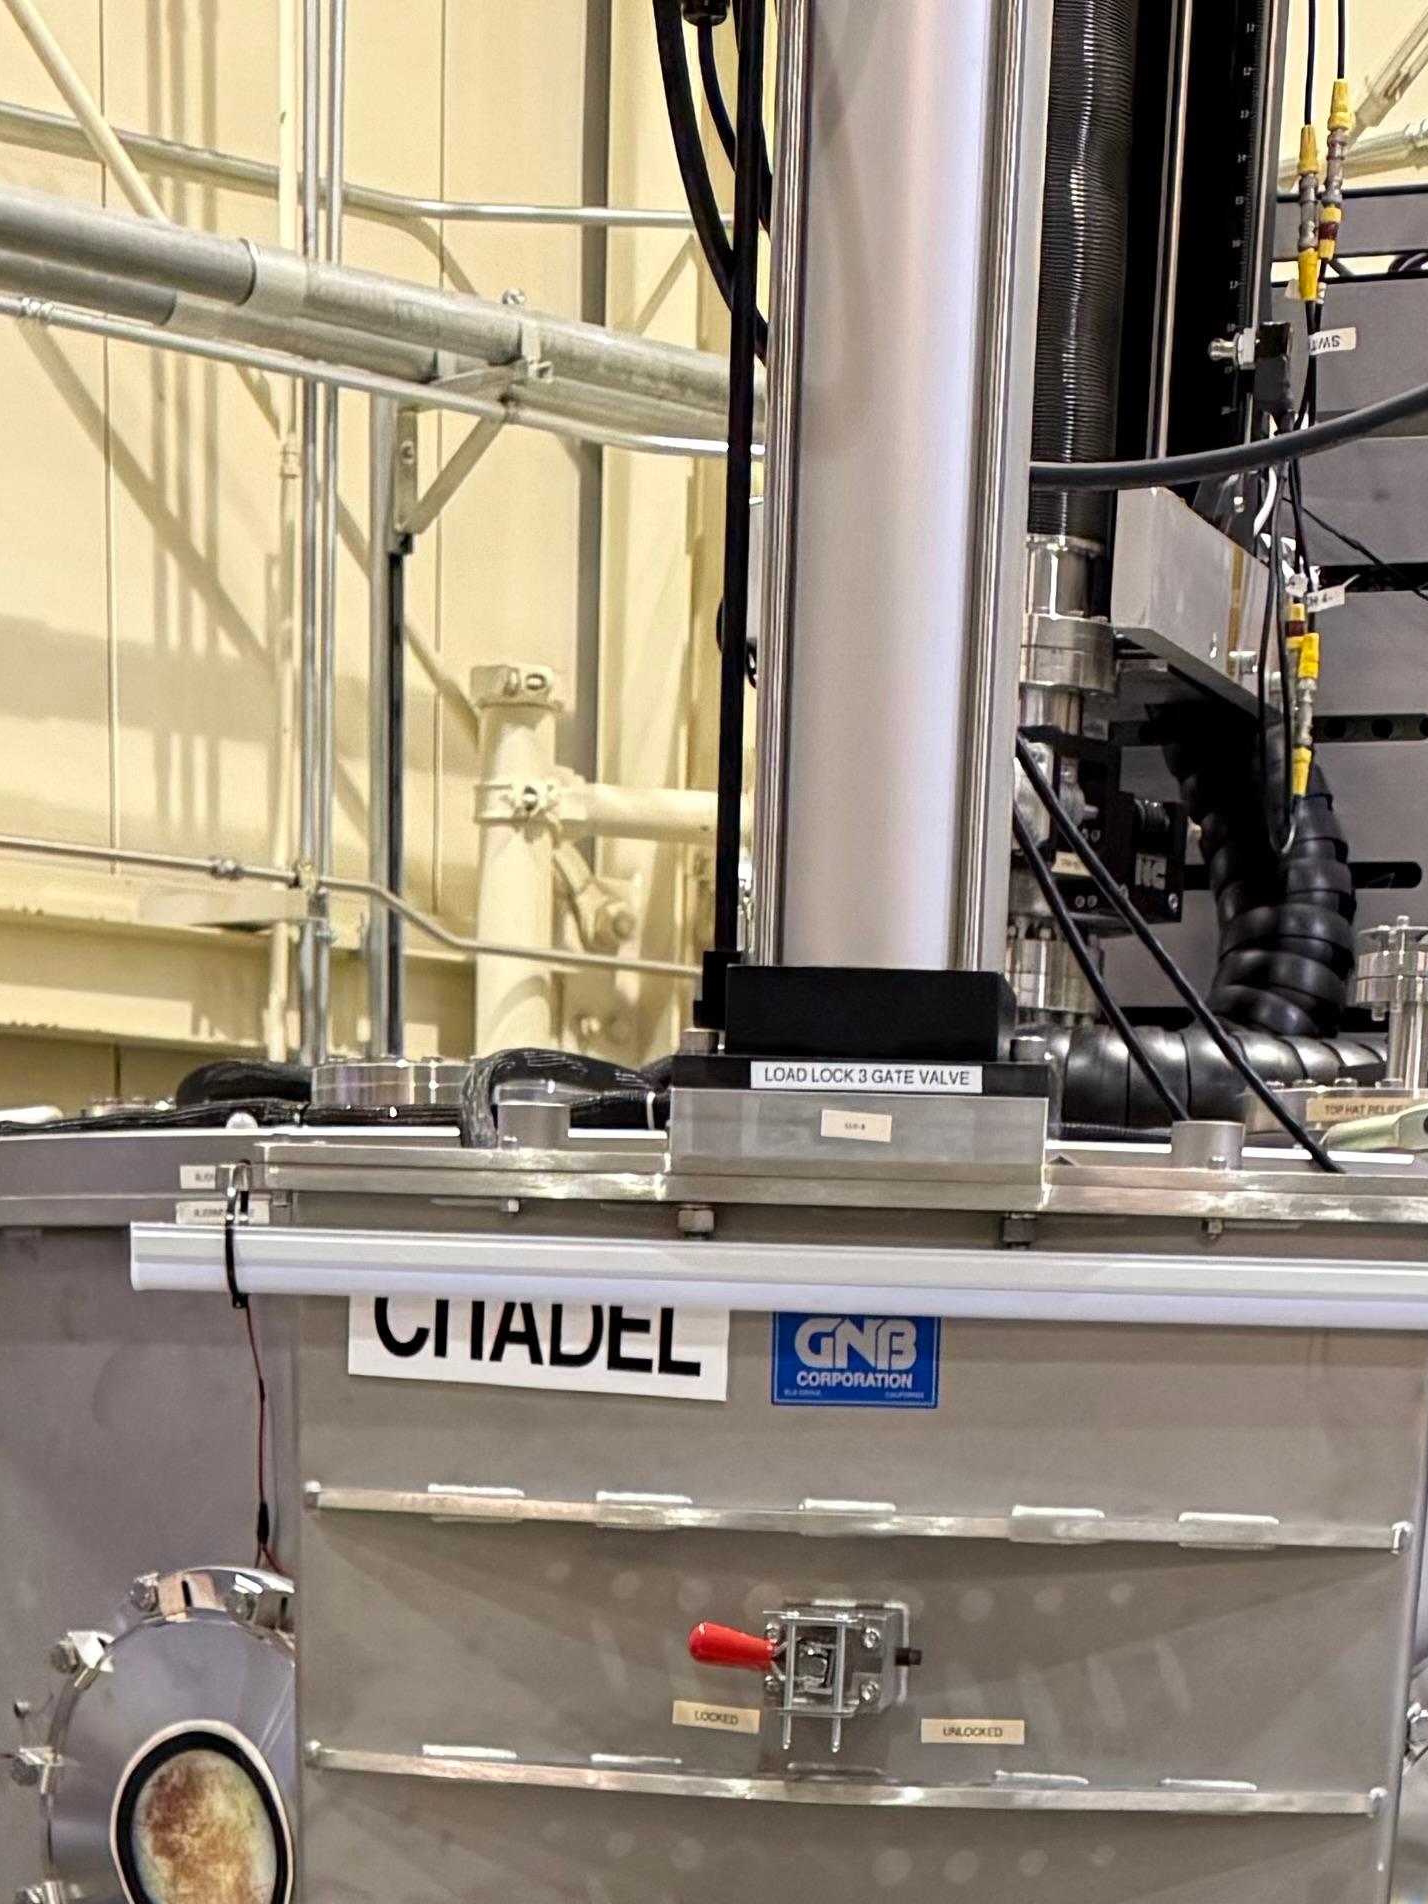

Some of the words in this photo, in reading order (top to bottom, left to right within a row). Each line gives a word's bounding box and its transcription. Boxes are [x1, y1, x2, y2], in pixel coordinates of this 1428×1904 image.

[764, 1066, 808, 1083] LOAD
[811, 1067, 855, 1083] LOCK
[858, 1069, 867, 1084] 3
[871, 1069, 915, 1085] GATE
[918, 1070, 970, 1086] VALVE
[794, 1317, 918, 1371] GNB
[796, 1370, 913, 1390] CORPORATION
[693, 1709, 740, 1726] LOCKED
[942, 1726, 1004, 1739] UNLOCKED
